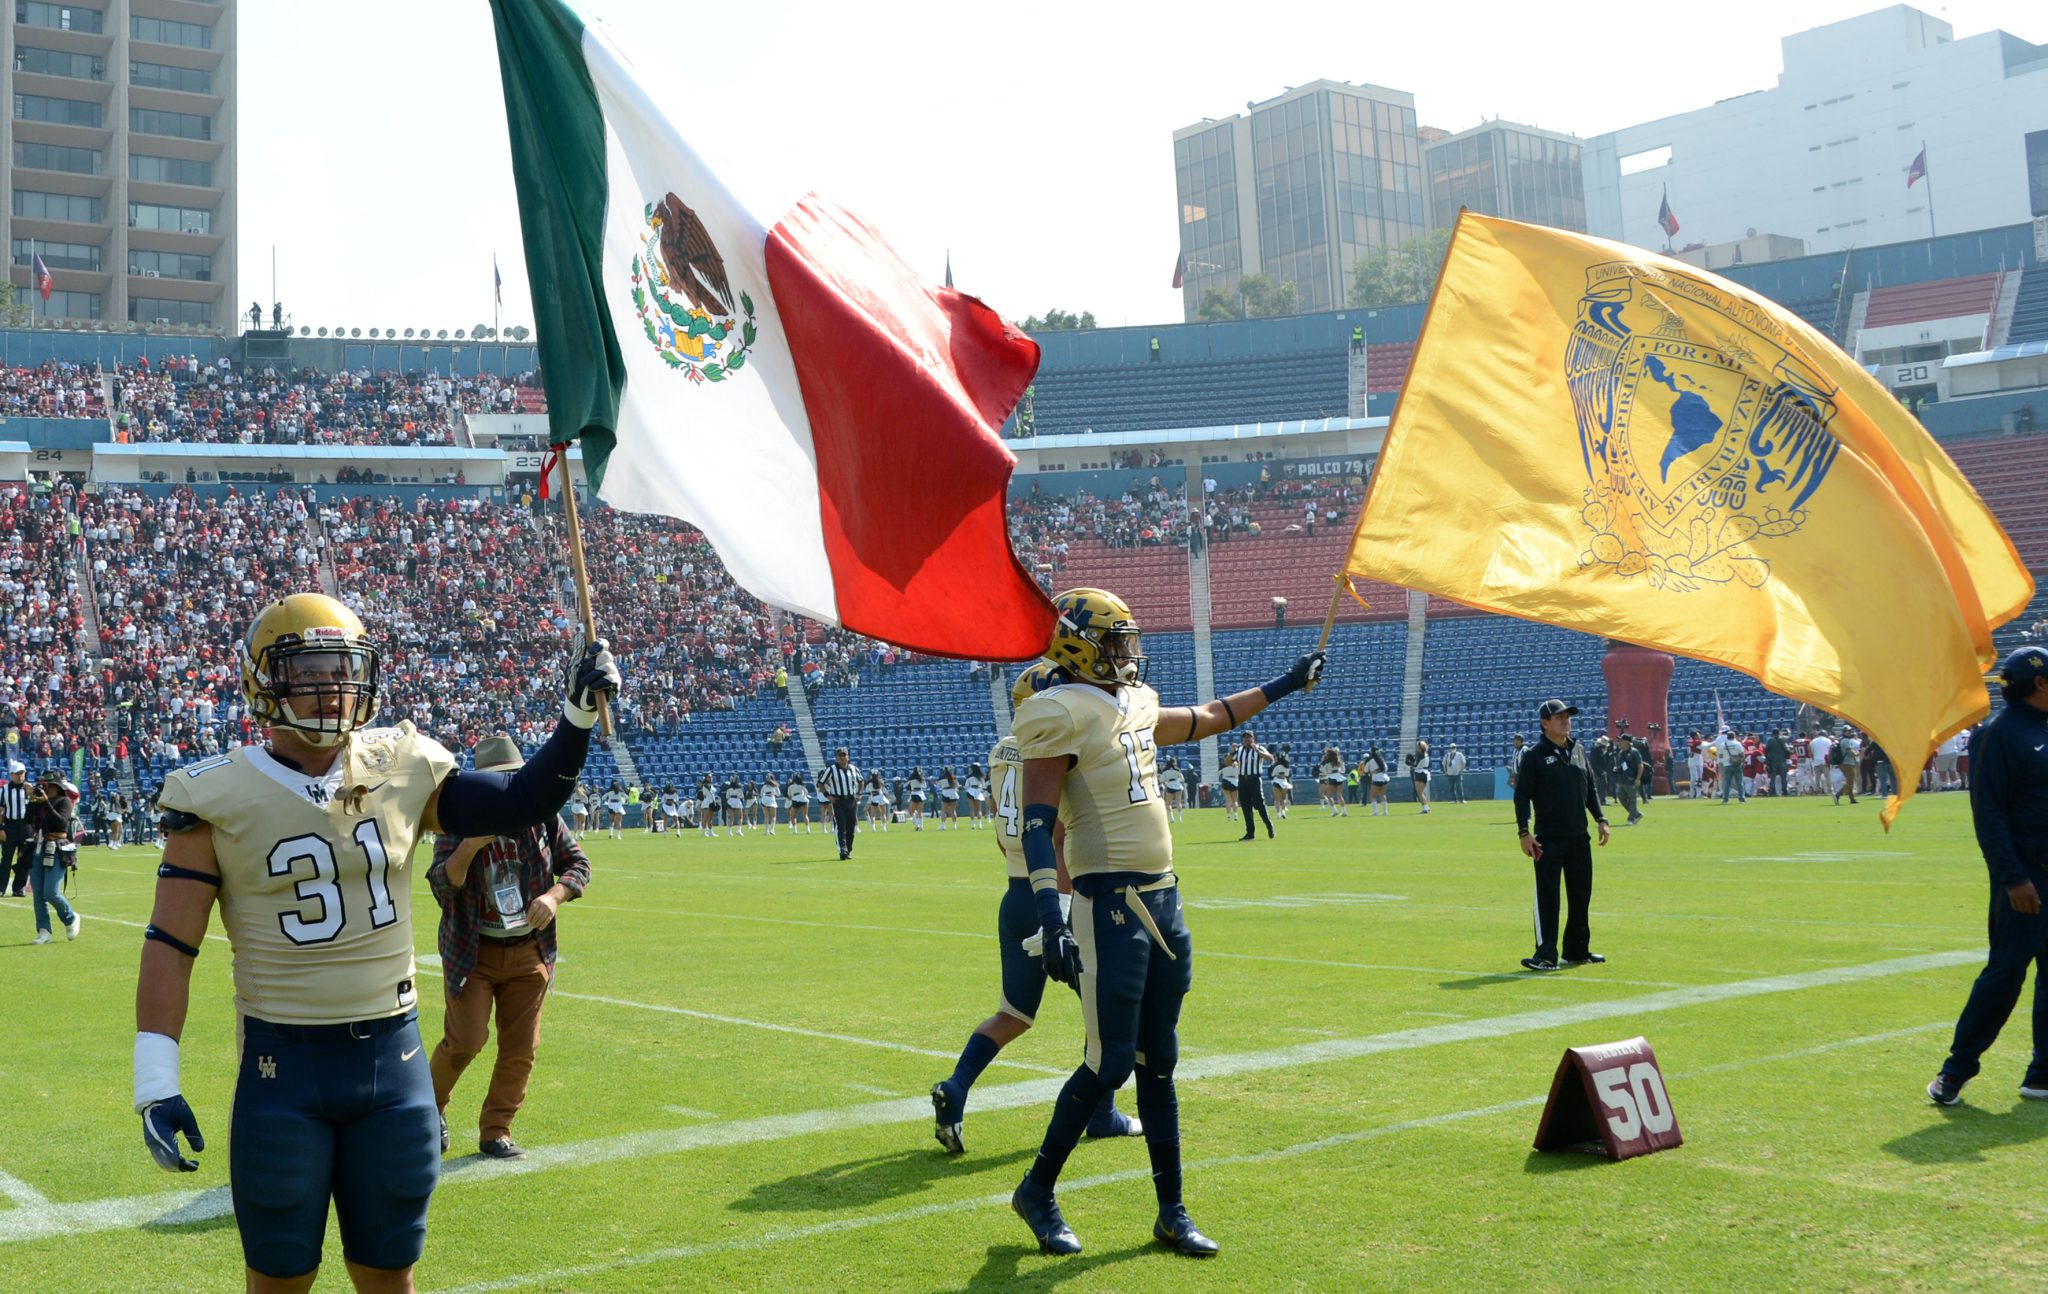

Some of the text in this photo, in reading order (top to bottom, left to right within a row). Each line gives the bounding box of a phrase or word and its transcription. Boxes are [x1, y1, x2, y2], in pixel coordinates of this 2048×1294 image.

[1669, 278, 1722, 307] NACIONAL
[1724, 301, 1783, 338] AUTONOMA
[1654, 341, 1696, 358] POR
[1897, 365, 1929, 382] 20
[36, 450, 63, 461] 24
[516, 456, 542, 467] 23
[1298, 461, 1341, 476] PALCO
[998, 763, 1019, 838] 4
[266, 817, 398, 946] 31
[1591, 1061, 1674, 1142] 50
